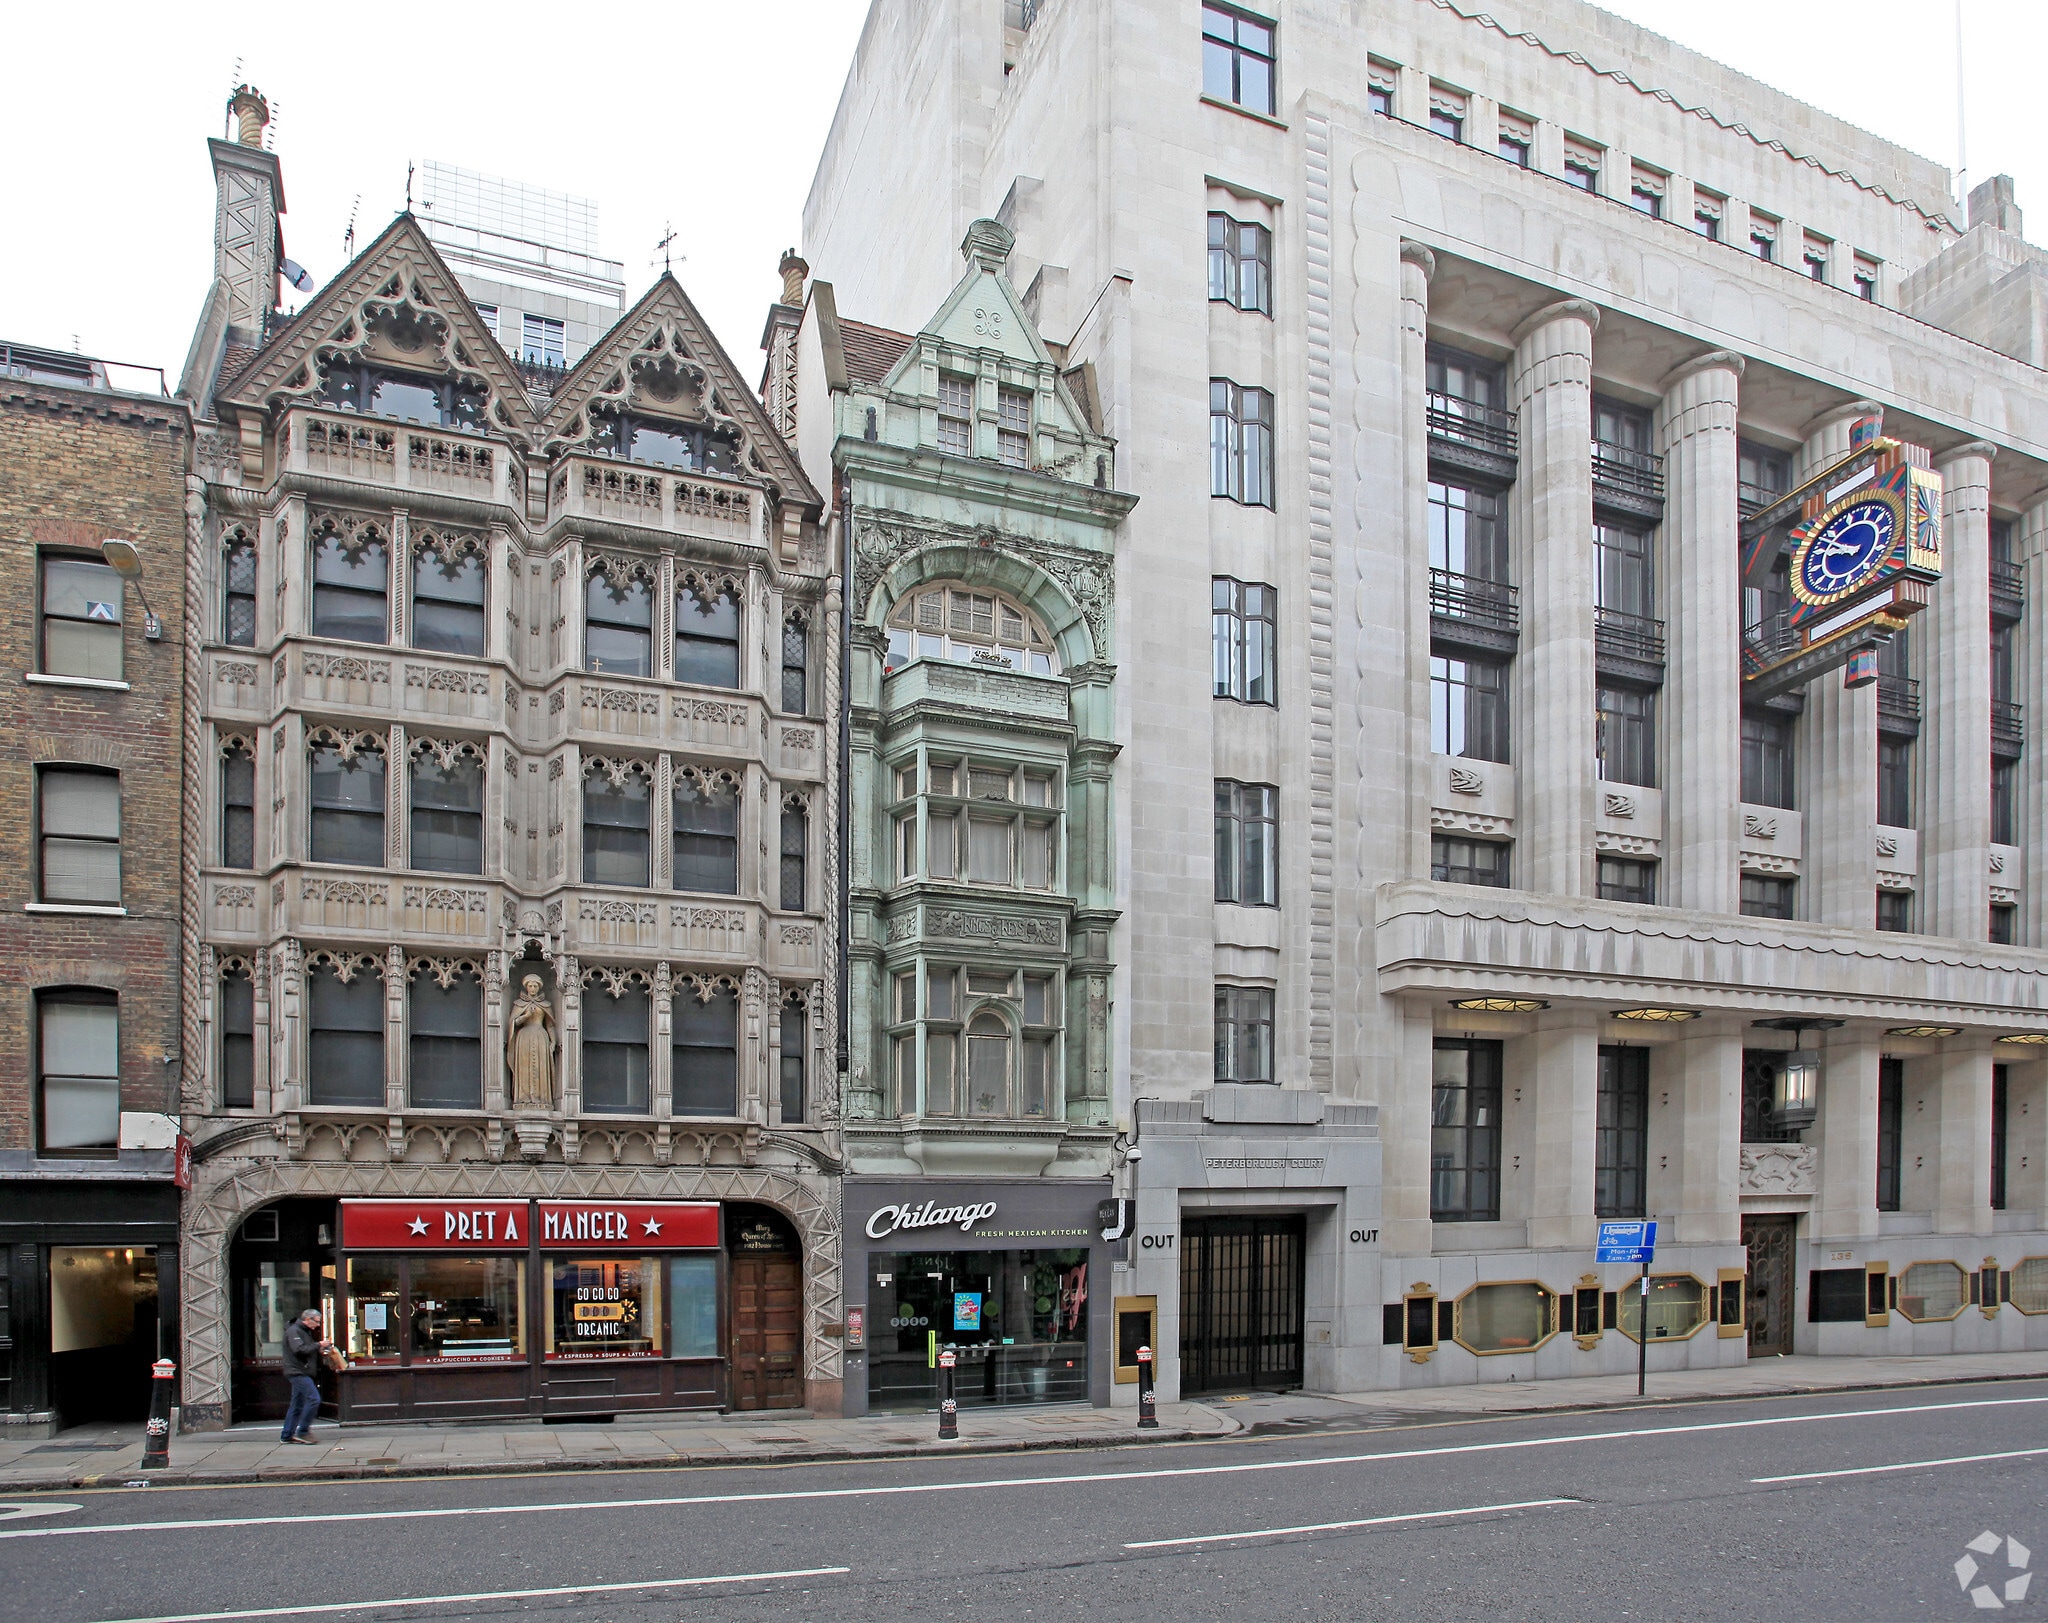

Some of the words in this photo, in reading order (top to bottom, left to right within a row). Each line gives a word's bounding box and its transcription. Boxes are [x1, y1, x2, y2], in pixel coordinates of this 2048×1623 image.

[1001, 919, 1025, 937] KEYS
[1206, 1159, 1286, 1169] PETERBOROUGH
[1291, 1158, 1324, 1169] COURT
[444, 1211, 497, 1240] PRET
[504, 1211, 519, 1240] A
[544, 1211, 629, 1240] MANGER
[865, 1200, 997, 1239] Chilango
[975, 1230, 1005, 1238] FRESH
[1050, 1228, 1089, 1236] KITCHEN
[1350, 1230, 1379, 1243] OUT
[1141, 1234, 1175, 1249] OUT
[577, 1287, 589, 1300] GO
[592, 1287, 604, 1300] GO
[607, 1287, 619, 1300] GO
[577, 1322, 620, 1336] ORGANIC
